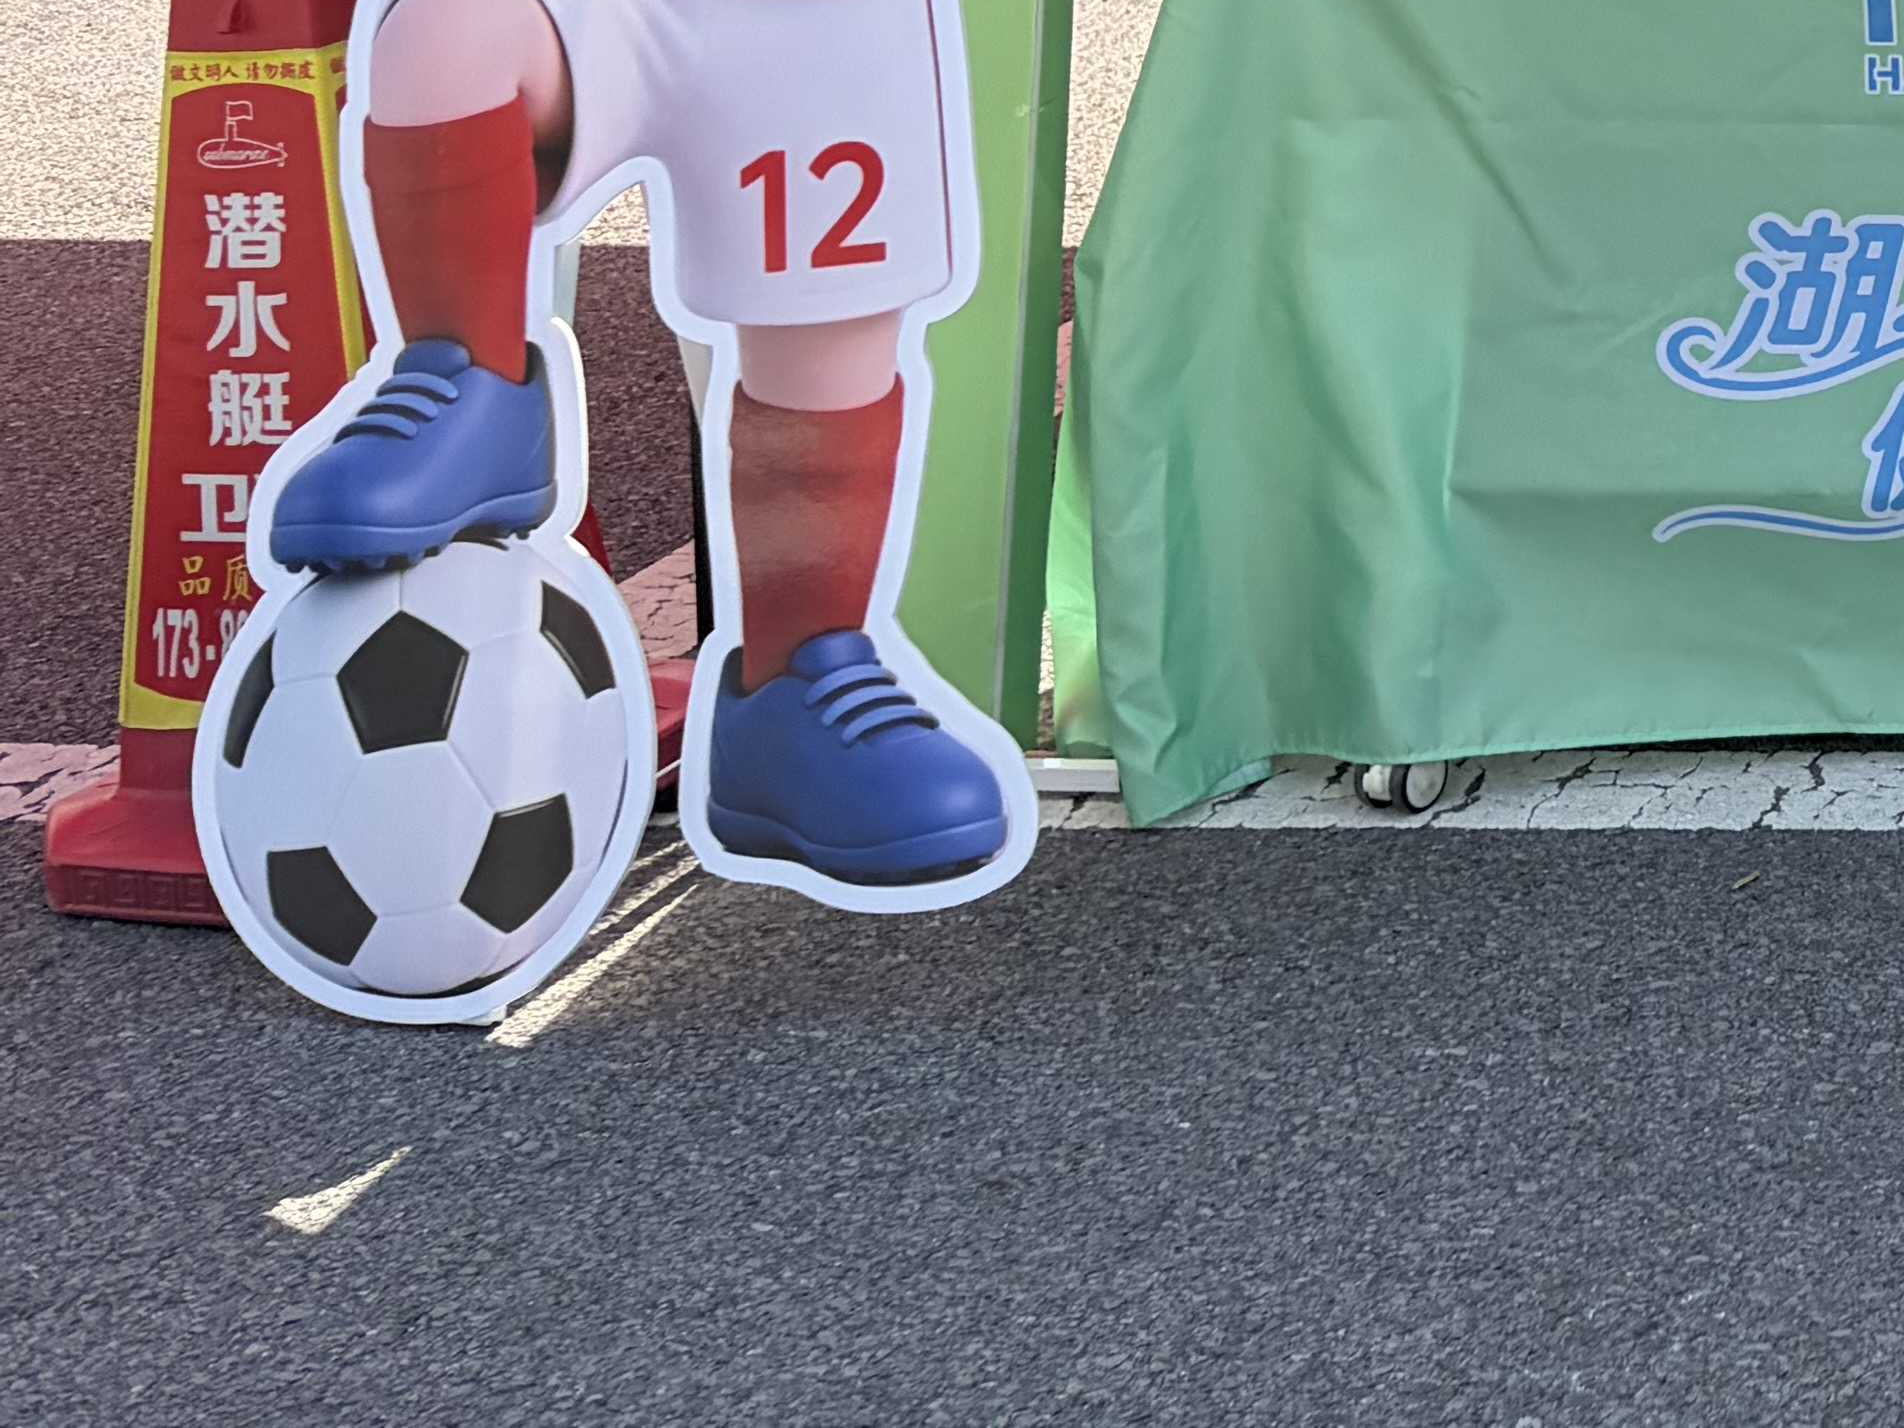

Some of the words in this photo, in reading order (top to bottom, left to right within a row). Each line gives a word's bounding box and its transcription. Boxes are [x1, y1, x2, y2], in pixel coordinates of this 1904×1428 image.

[738, 141, 890, 275] 12
[203, 191, 292, 446] 潜水艇
